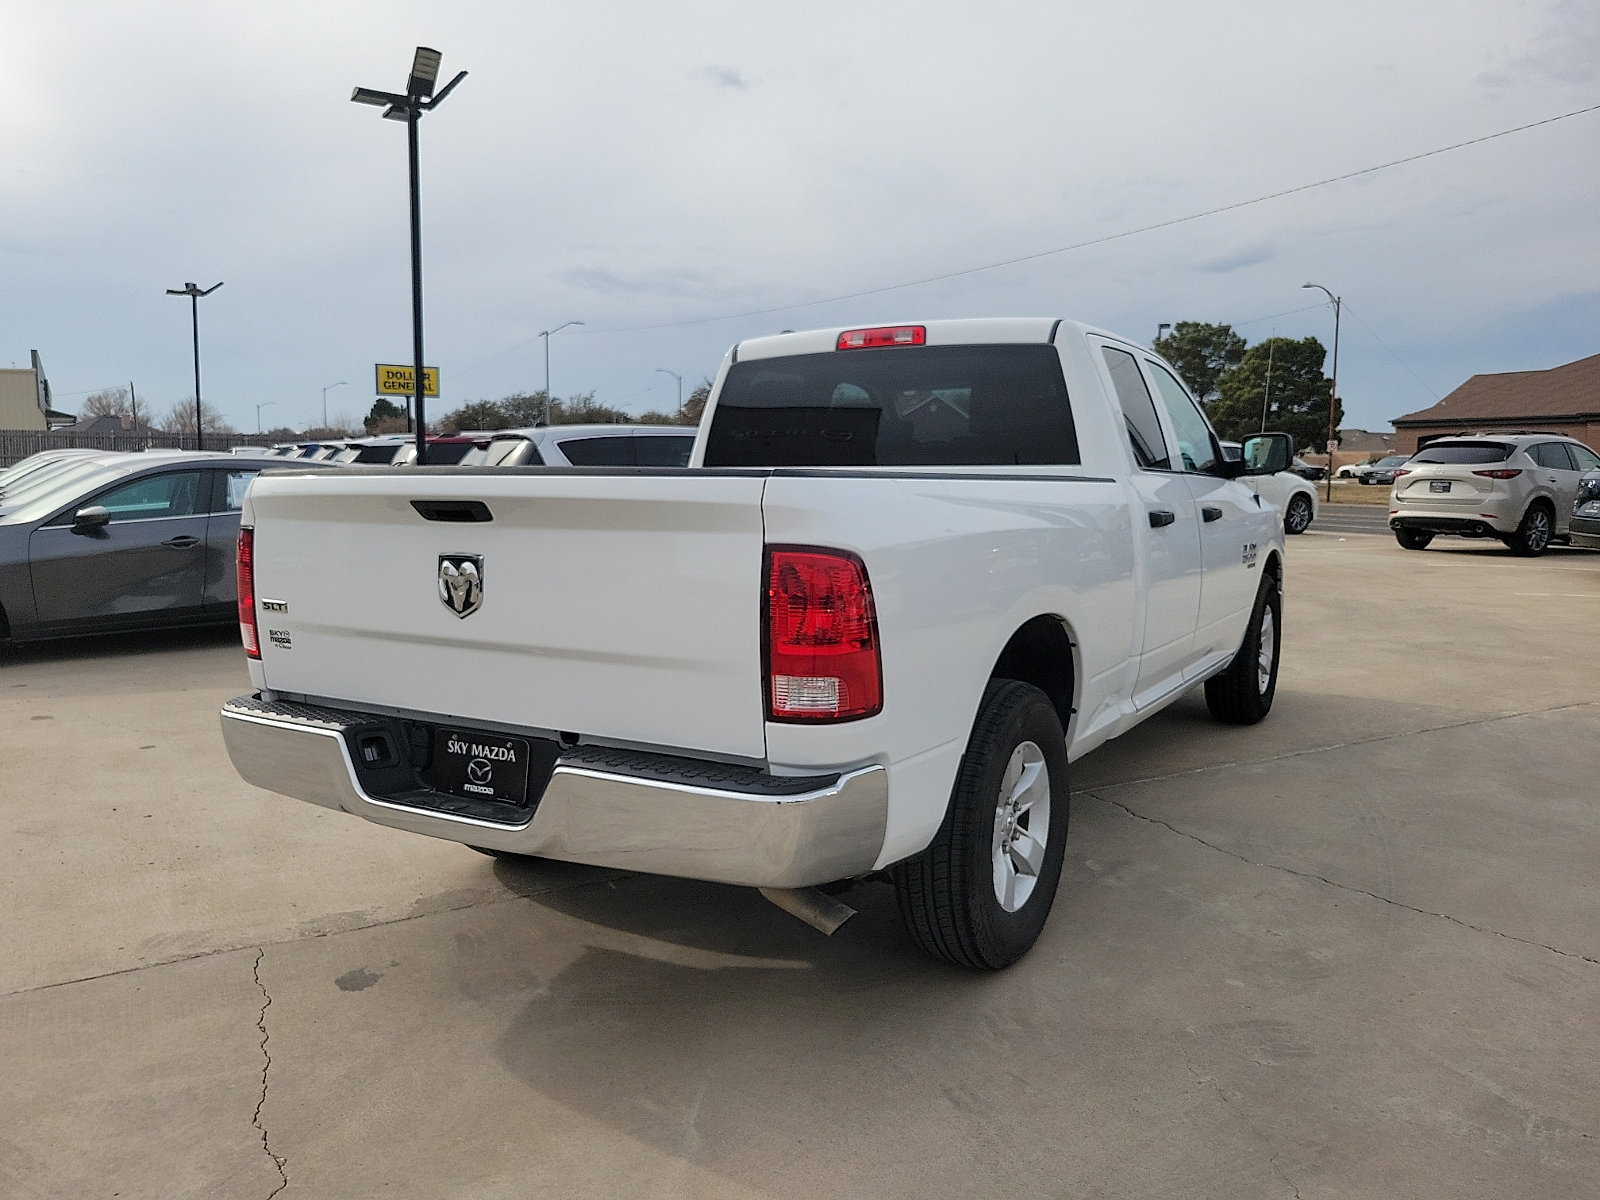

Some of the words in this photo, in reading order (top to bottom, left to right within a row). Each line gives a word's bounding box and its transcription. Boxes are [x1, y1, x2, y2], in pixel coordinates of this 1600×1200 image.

[386, 370, 431, 382] DOLLR
[383, 380, 435, 392] GENEL
[447, 740, 469, 755] SKY
[471, 743, 516, 763] MAZDA
[463, 783, 494, 795] mazda
